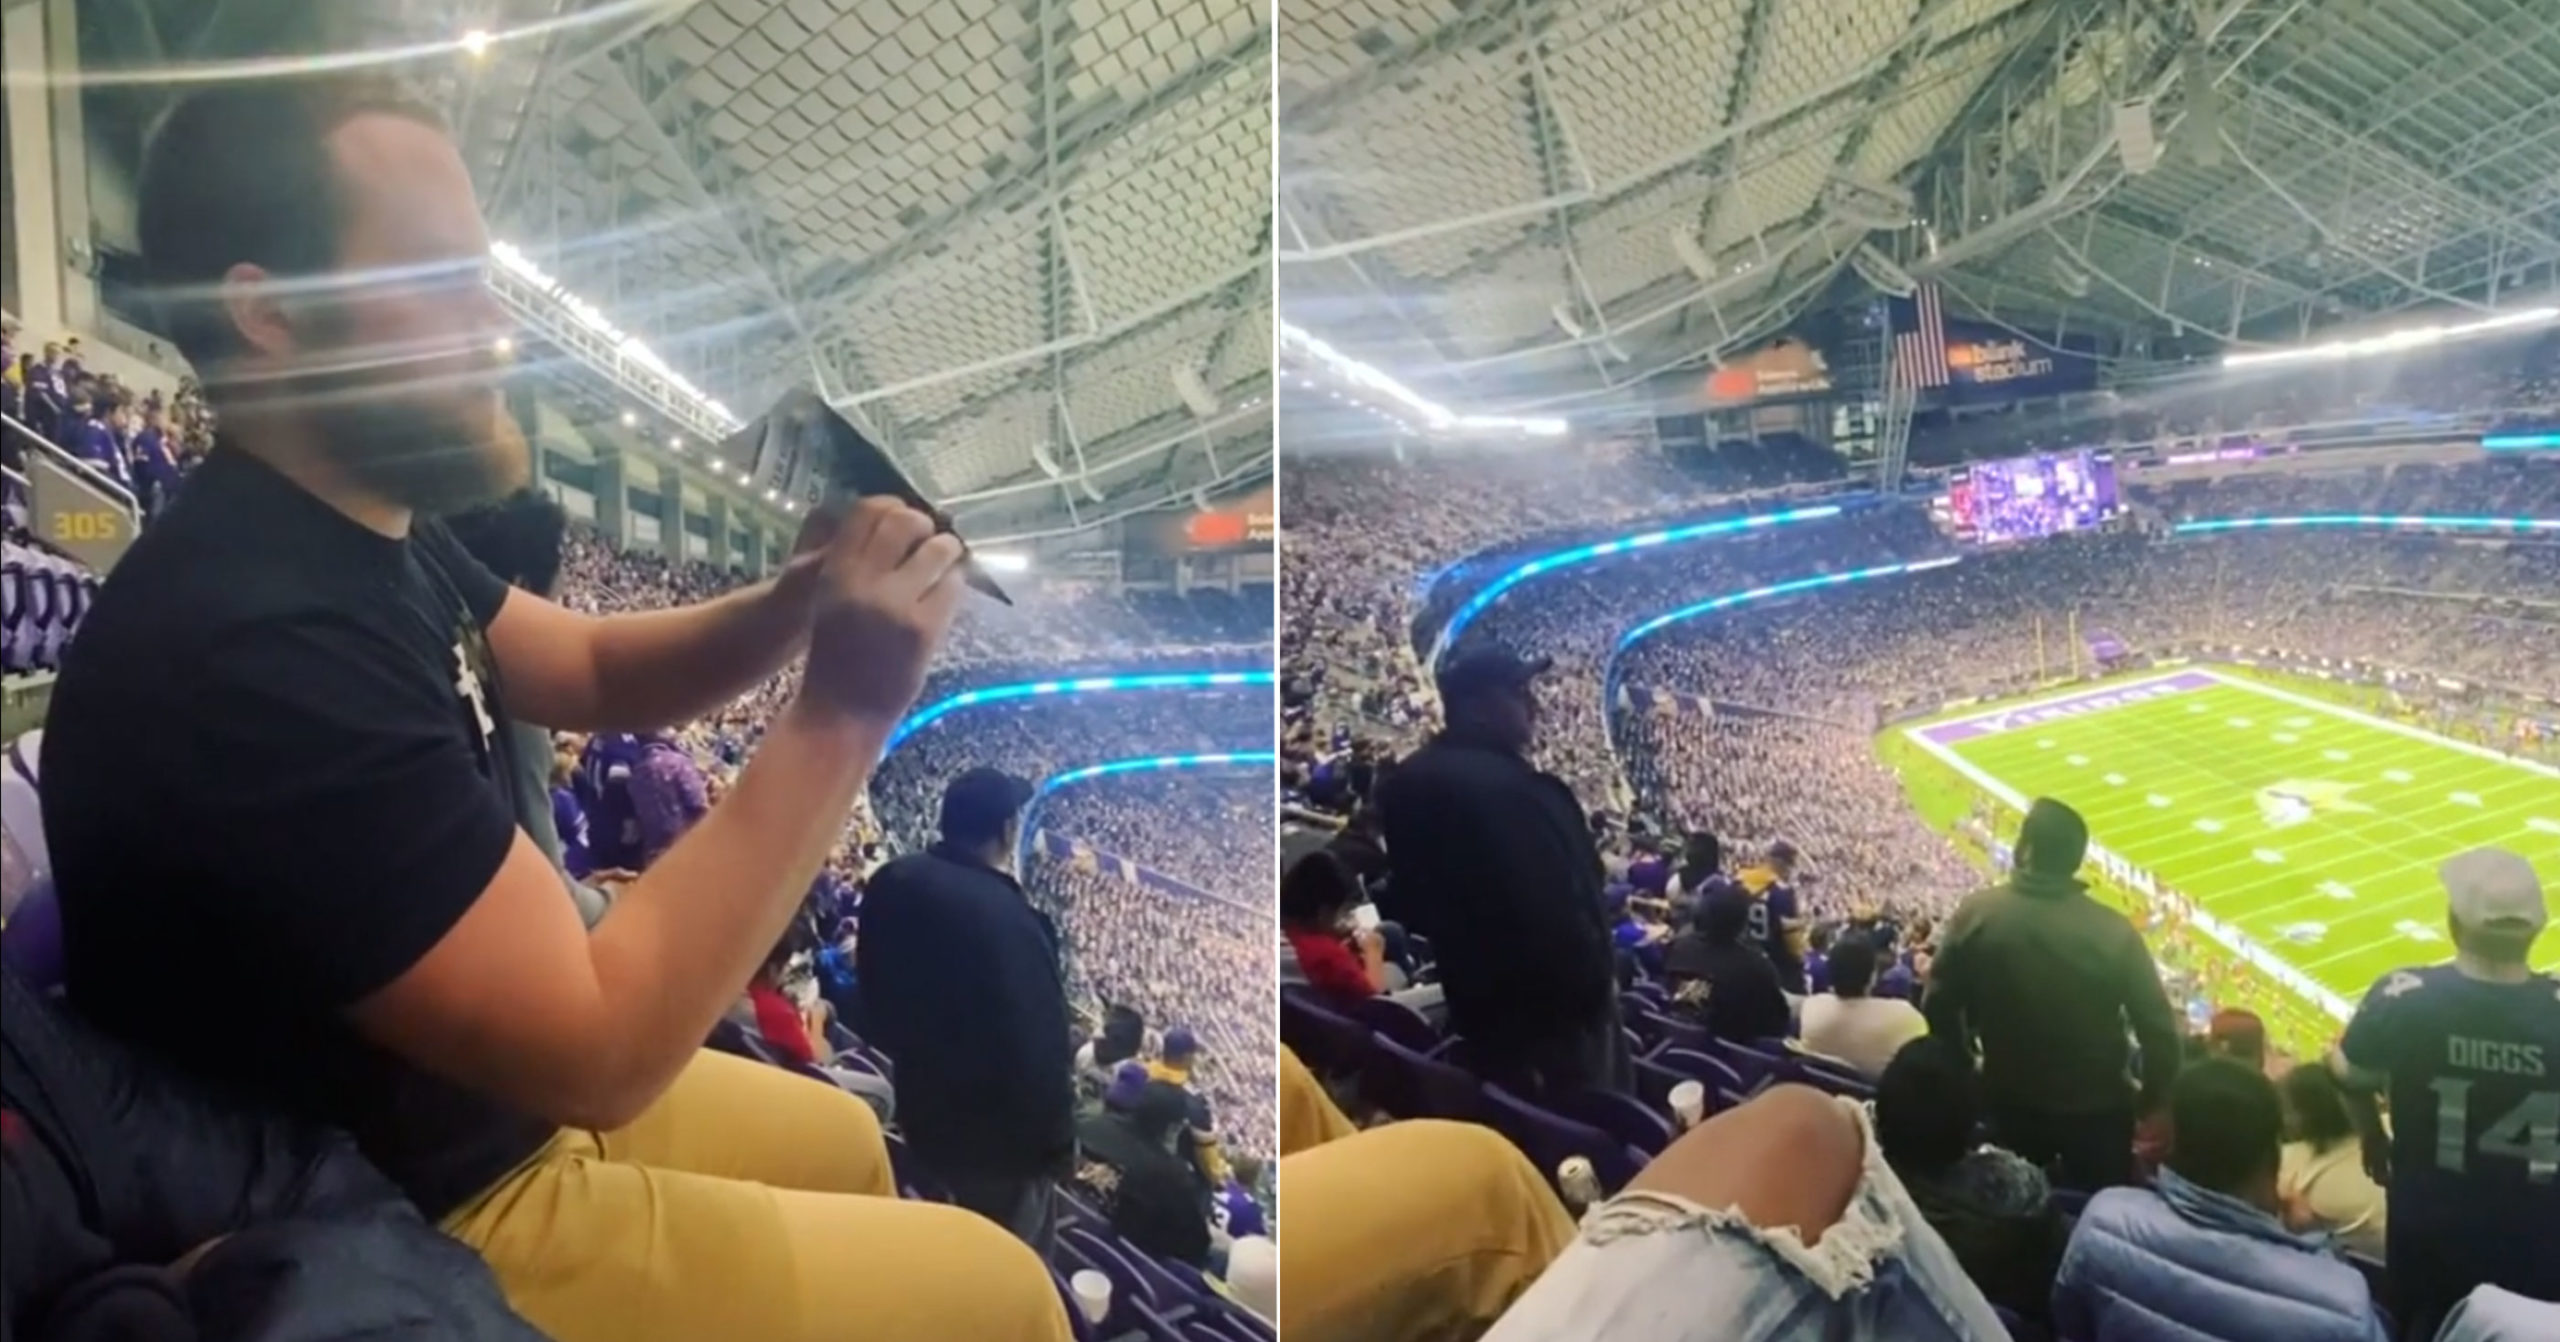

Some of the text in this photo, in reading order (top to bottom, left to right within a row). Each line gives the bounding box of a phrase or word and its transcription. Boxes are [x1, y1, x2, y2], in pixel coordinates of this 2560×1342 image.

[1974, 358, 2053, 383] stadium
[53, 512, 117, 540] 305
[2448, 1034, 2546, 1077] DIGGS
[2426, 1076, 2560, 1184] 14
